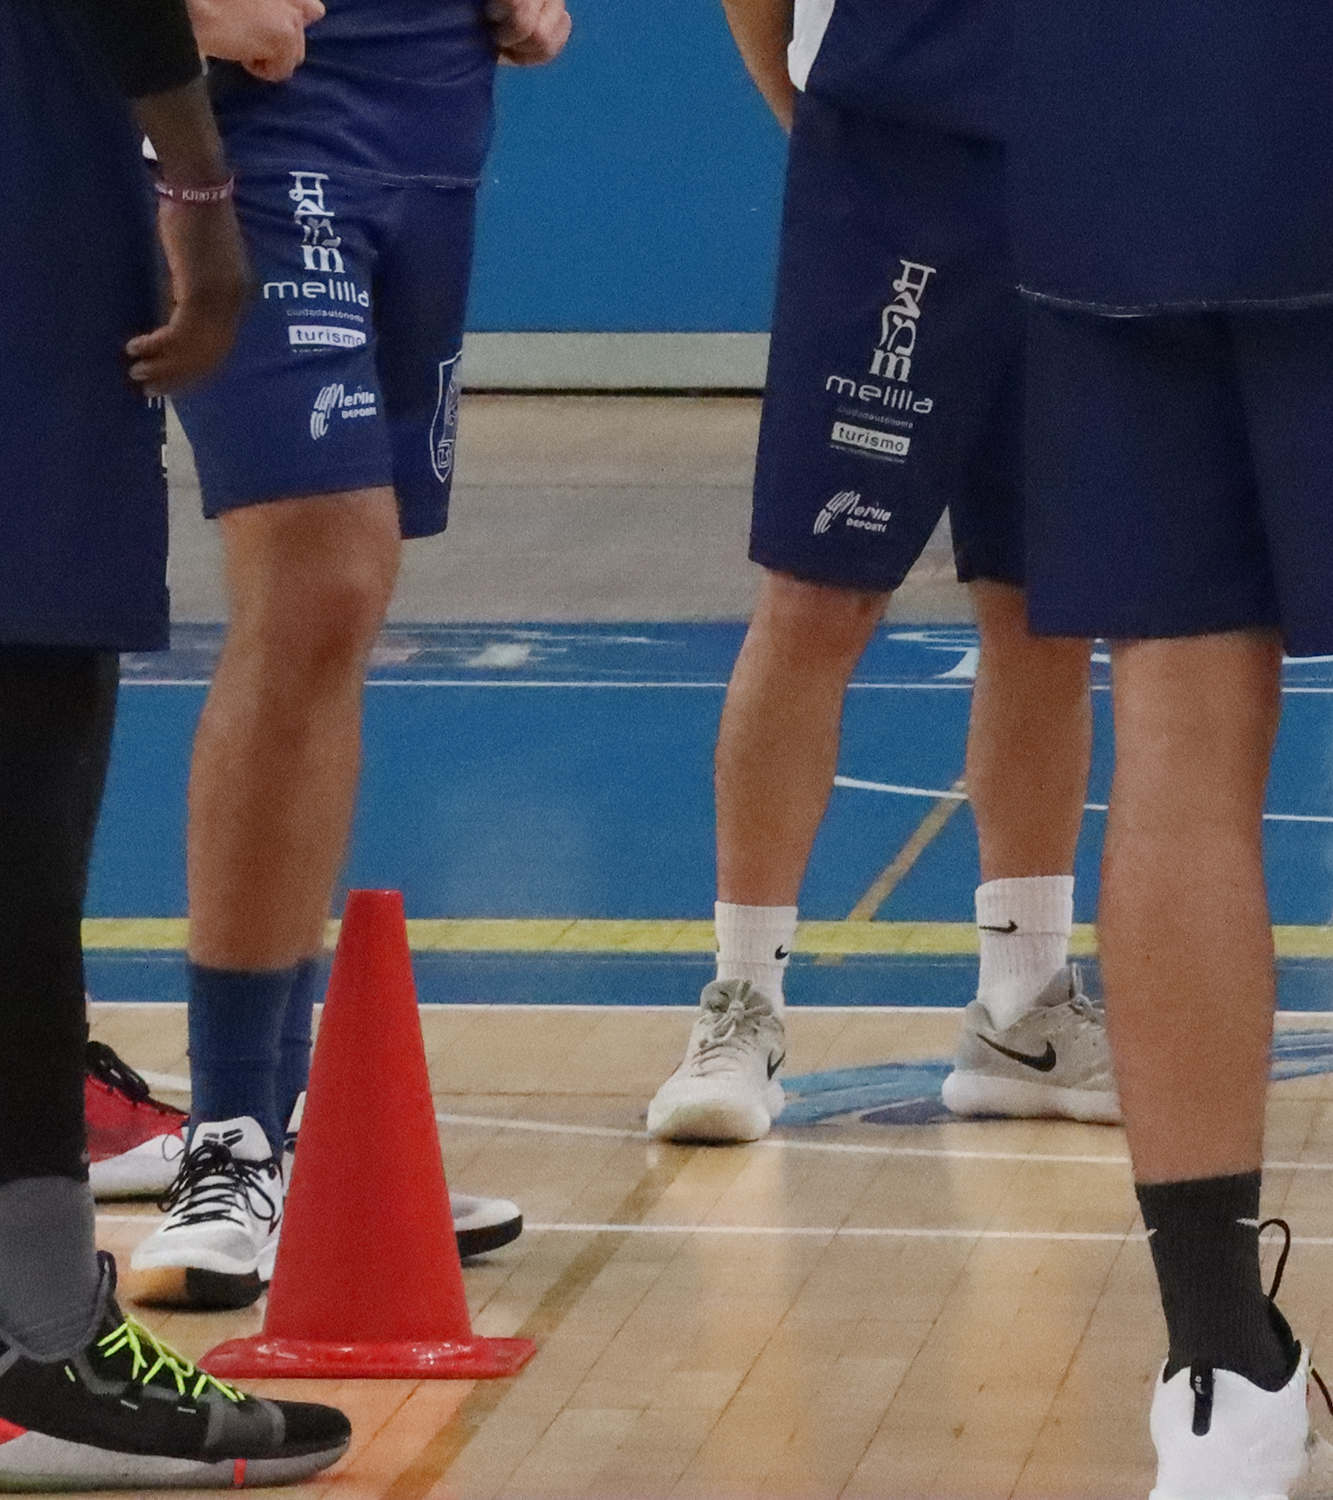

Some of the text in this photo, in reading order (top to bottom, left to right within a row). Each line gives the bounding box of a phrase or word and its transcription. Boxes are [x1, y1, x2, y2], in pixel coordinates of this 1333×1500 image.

[263, 278, 370, 308] melilla
[296, 329, 363, 346] turismo
[825, 375, 934, 414] melilla
[839, 427, 904, 452] turismo
